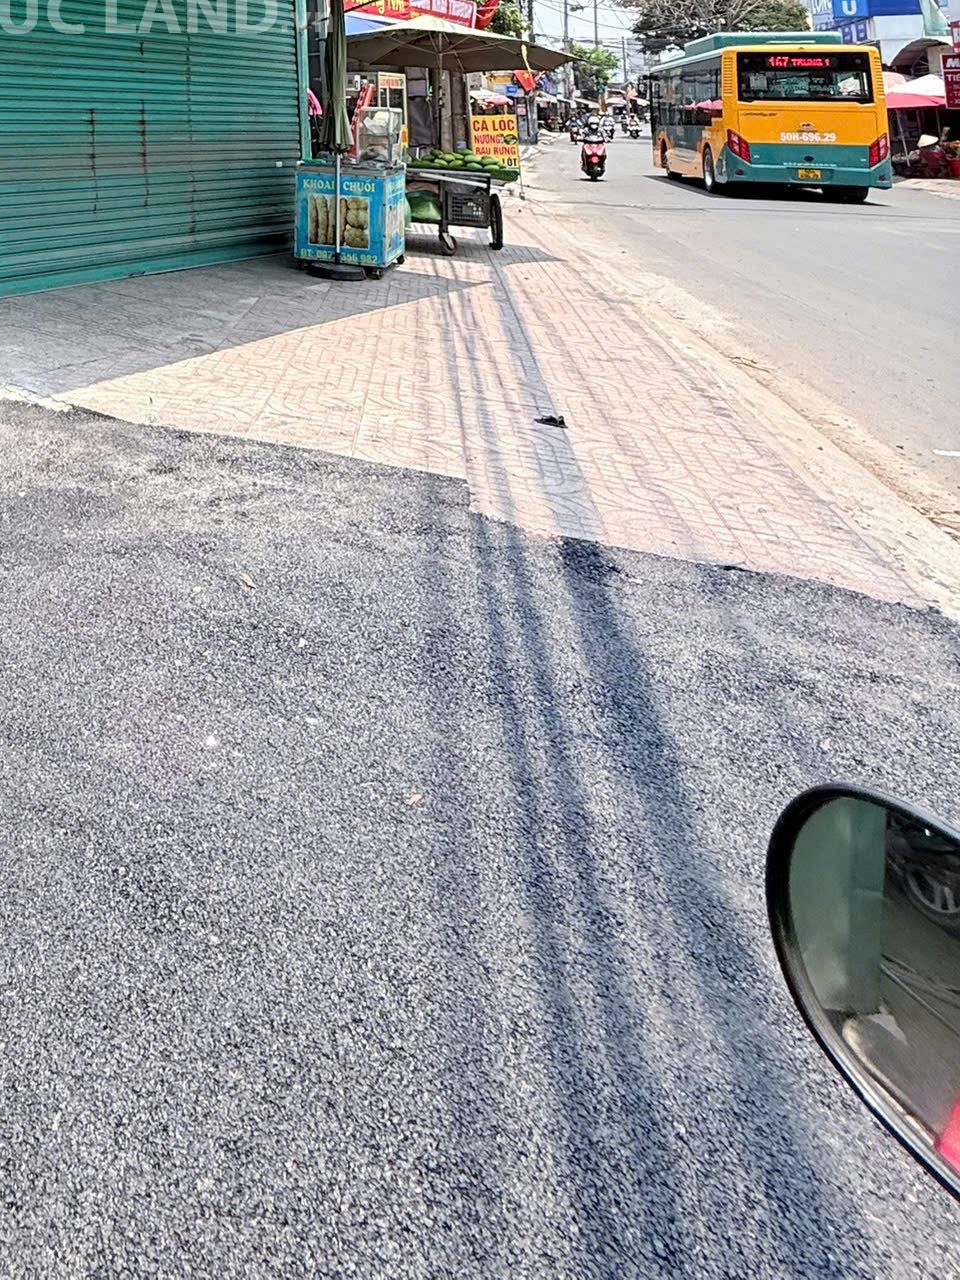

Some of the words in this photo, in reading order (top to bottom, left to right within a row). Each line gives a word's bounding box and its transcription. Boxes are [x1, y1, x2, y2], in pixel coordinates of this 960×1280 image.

[780, 132, 836, 143] 50H-696.29
[303, 179, 336, 191] KHOAI
[342, 179, 376, 192] CHUỐI
